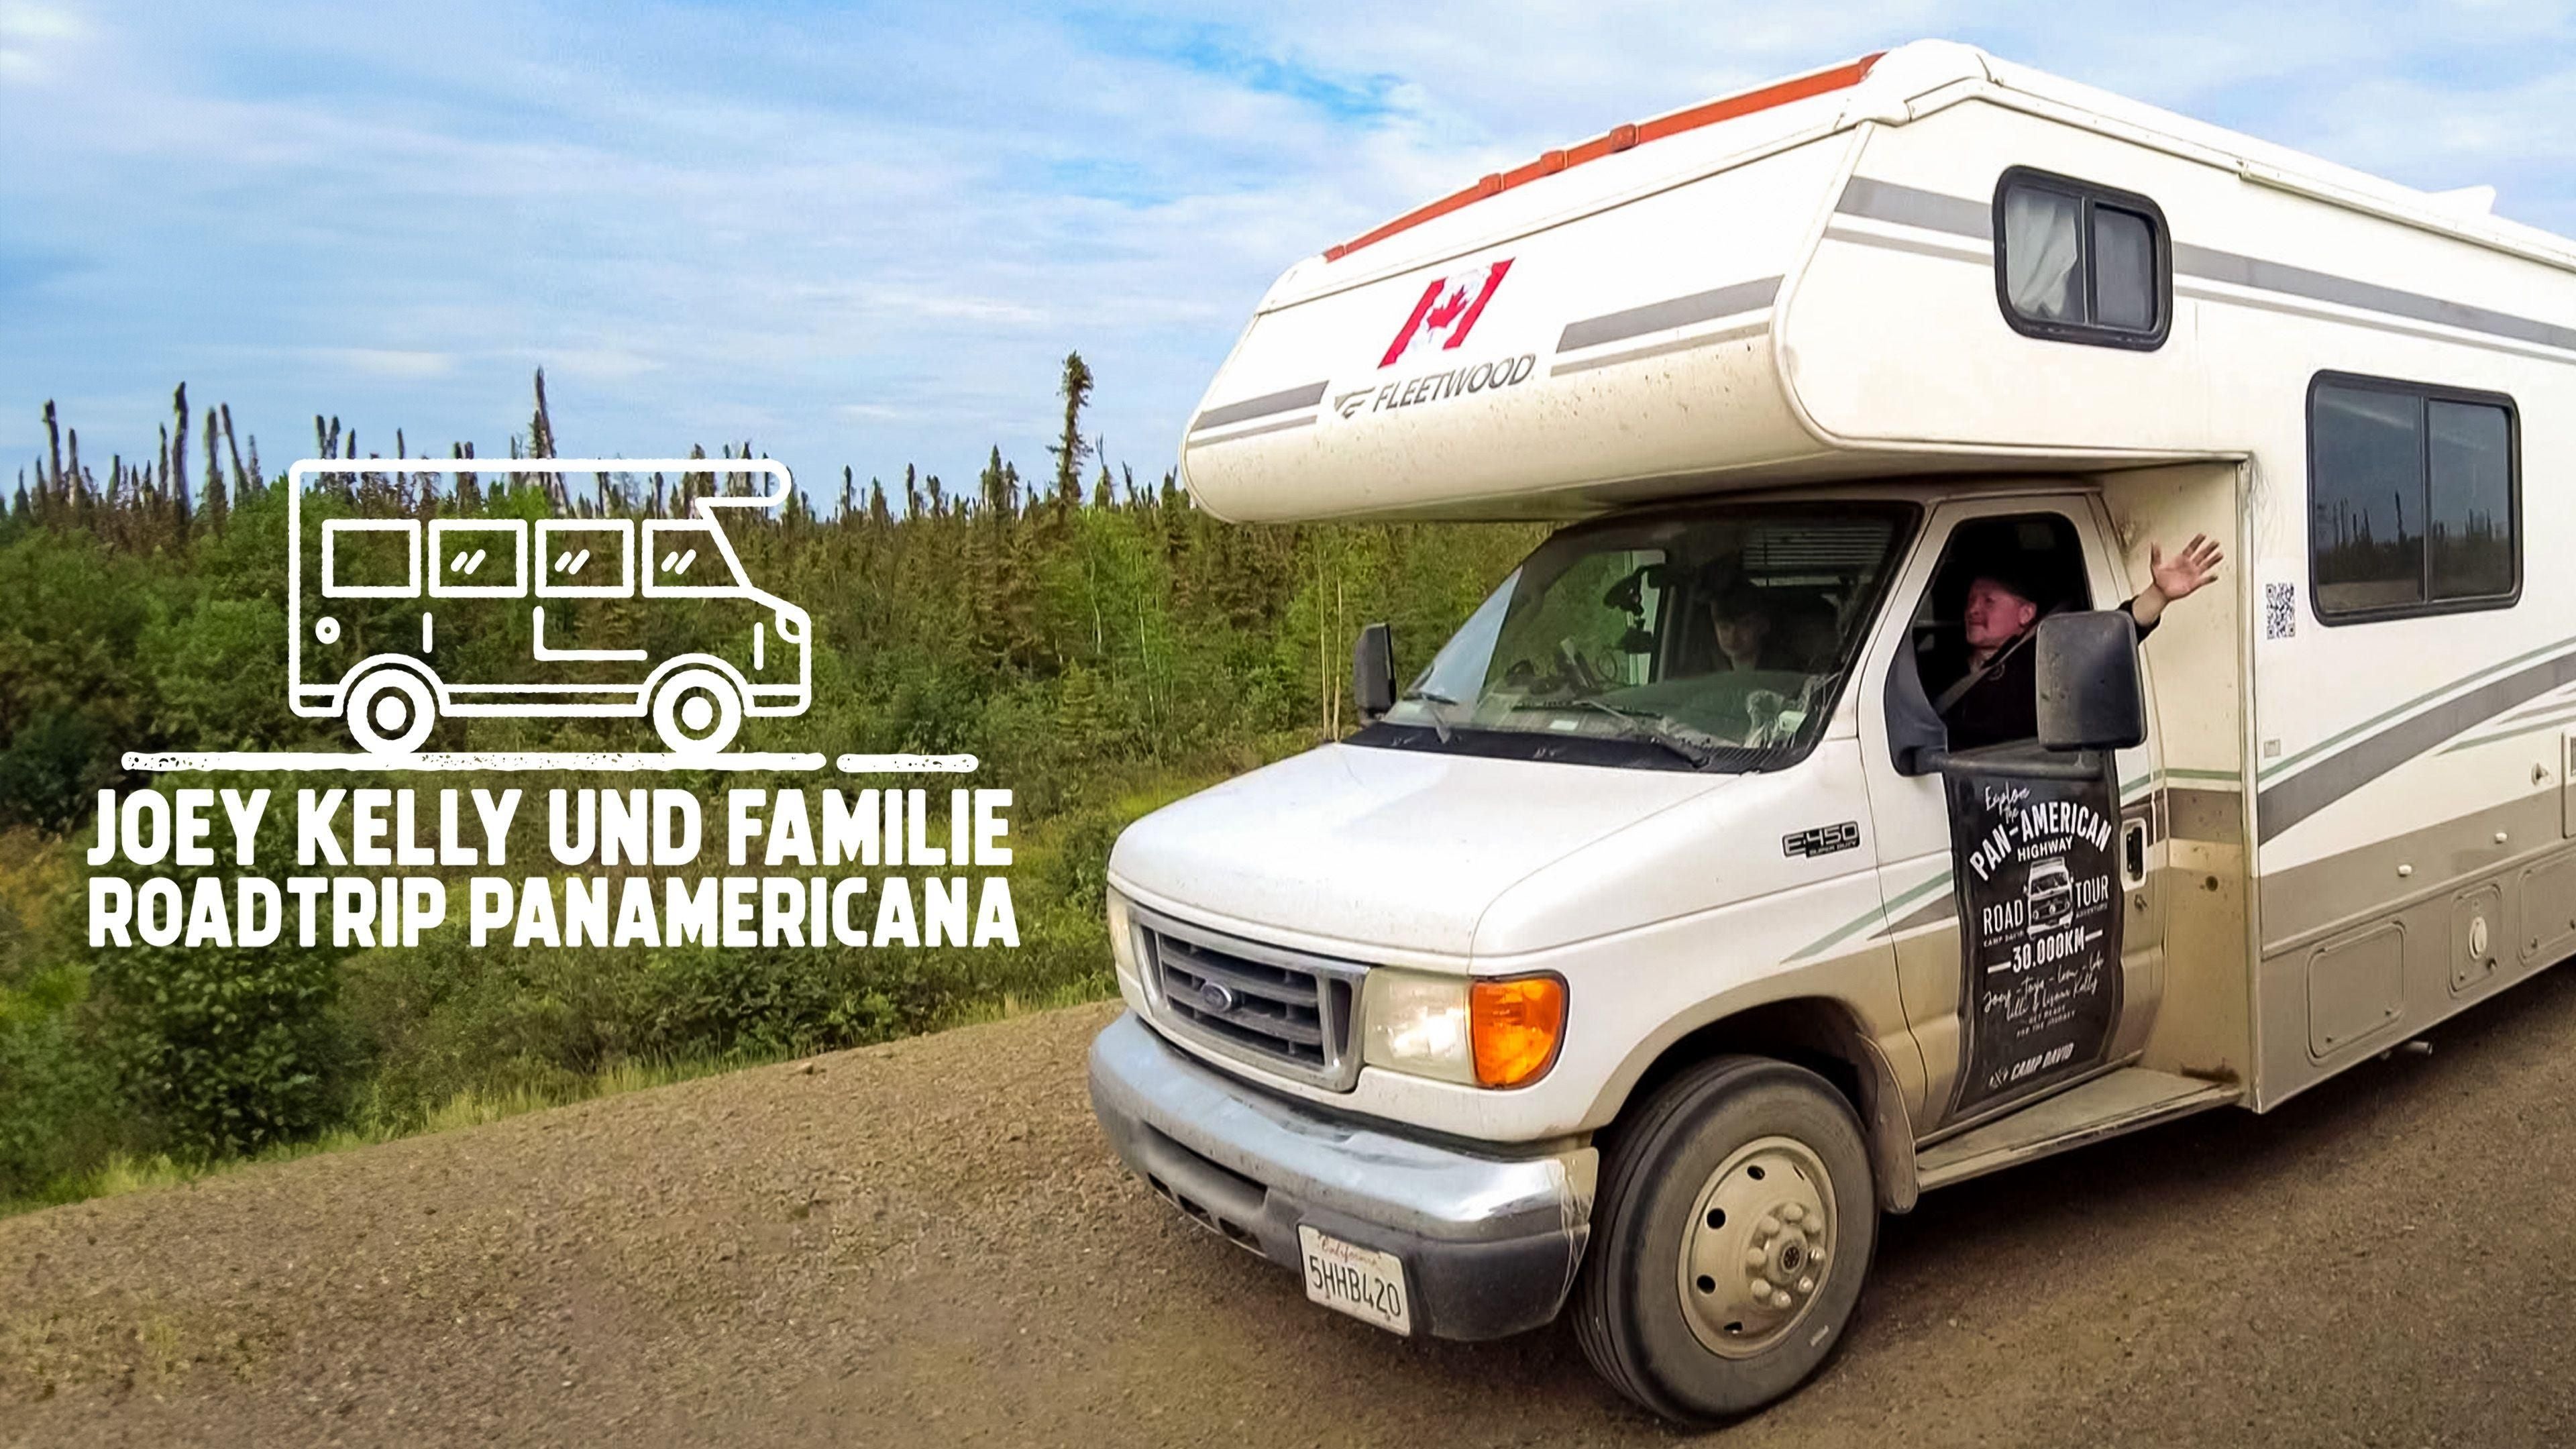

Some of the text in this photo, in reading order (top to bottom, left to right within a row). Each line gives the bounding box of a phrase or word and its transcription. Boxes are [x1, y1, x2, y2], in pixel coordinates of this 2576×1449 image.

[1373, 354, 1536, 413] FLEETWOOD
[1970, 801, 2112, 881] PAN-AMERICAN
[2017, 835, 2074, 862] HIGHWAY
[1982, 875, 2109, 936] ROAD TOUR
[2012, 926, 2085, 973] 30.000KM
[2010, 1053, 2043, 1081] CAMP
[1309, 1255, 1401, 1317] 5HHB420
